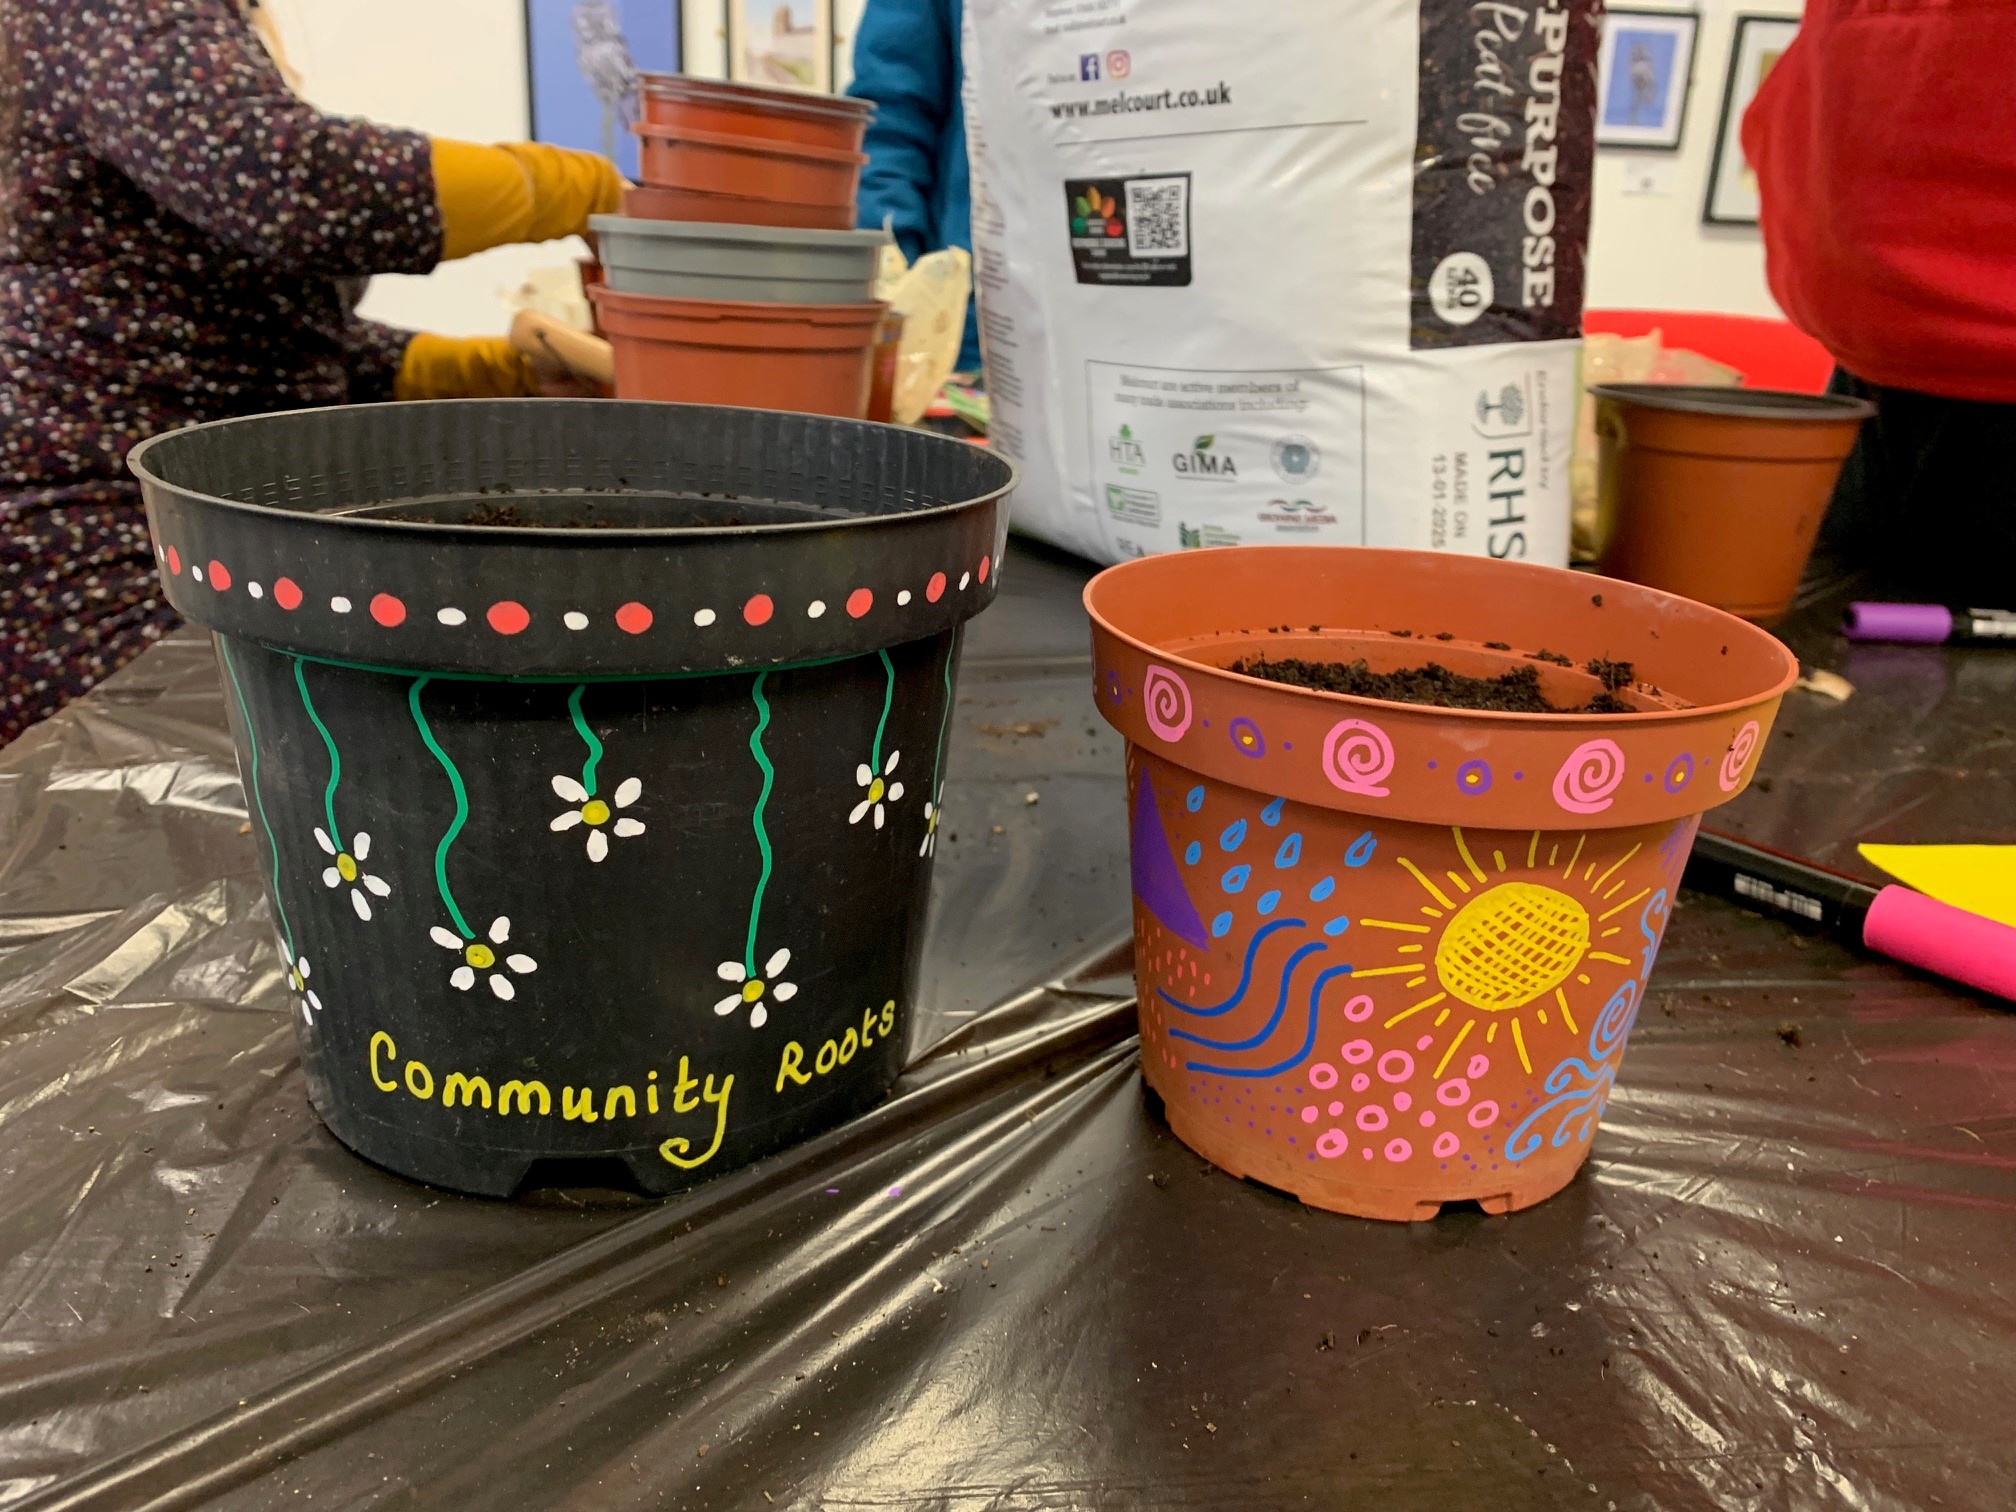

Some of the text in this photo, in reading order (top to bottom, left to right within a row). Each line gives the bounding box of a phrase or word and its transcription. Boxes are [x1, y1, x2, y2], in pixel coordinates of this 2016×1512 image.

[1050, 81, 1232, 119] www.melcourt.co.uk
[1457, 267, 1481, 308] 40
[1217, 381, 1282, 394] members
[1111, 440, 1145, 465] HTA
[1173, 452, 1238, 476] GIMA
[1453, 452, 1469, 539] MADE ON
[1489, 449, 1527, 558] RHS
[369, 1000, 896, 1169] Community Roots
